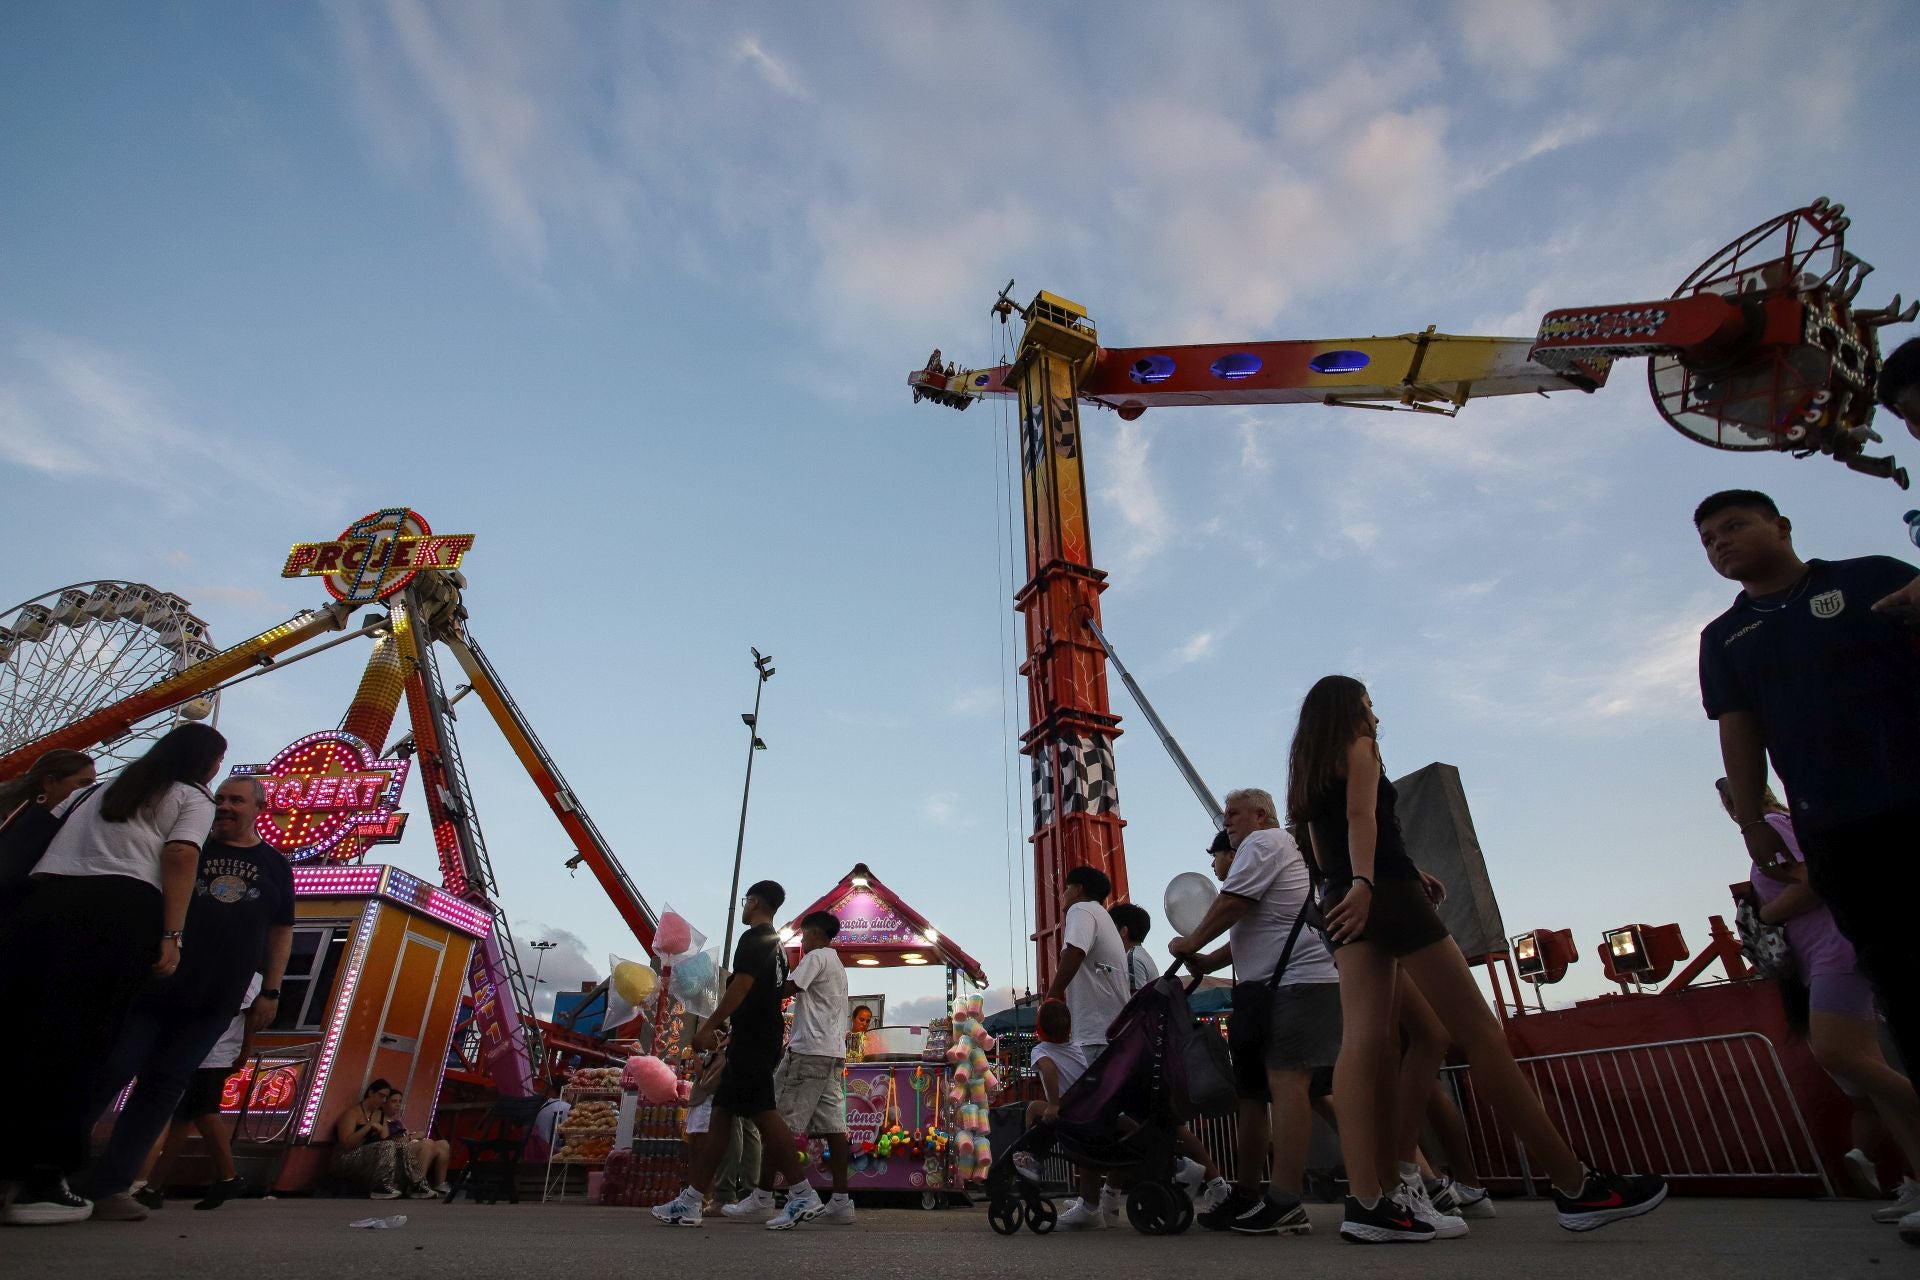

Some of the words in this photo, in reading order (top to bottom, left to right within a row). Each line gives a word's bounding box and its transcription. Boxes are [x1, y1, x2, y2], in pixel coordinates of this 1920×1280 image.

[287, 537, 469, 574] PROJEKT
[258, 775, 385, 809] ROJEKT
[870, 916, 897, 930] dulce
[846, 1108, 884, 1126] dones
